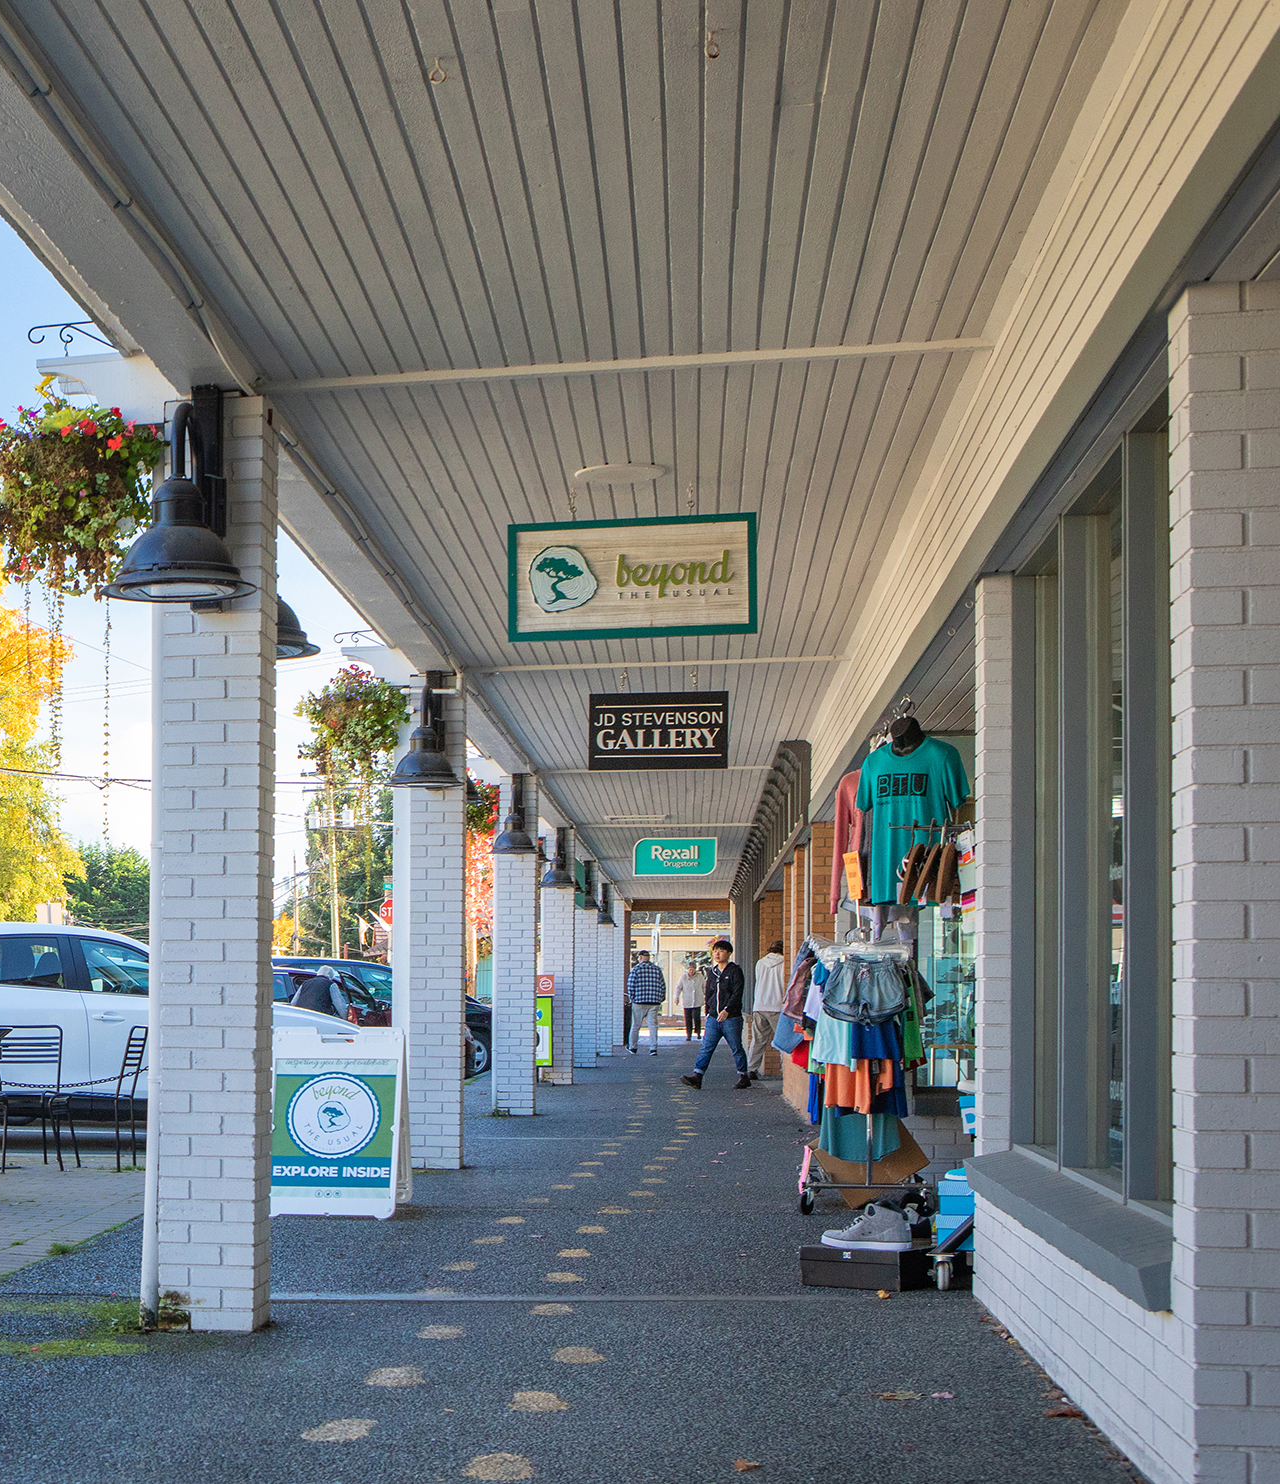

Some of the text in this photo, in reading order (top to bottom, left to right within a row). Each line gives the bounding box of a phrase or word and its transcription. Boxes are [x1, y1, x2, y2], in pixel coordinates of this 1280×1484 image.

[616, 549, 735, 598] beyond
[617, 588, 734, 599] THE USUAL
[593, 711, 724, 727] JD STEVENSON
[596, 727, 721, 750] GALLERY
[877, 773, 928, 798] BTU
[651, 845, 699, 861] Rexall
[312, 1085, 362, 1101] beyond
[304, 1123, 320, 1141] THE
[327, 1124, 363, 1146] USUAL
[272, 1165, 391, 1178] EXPLORE INSIDE
